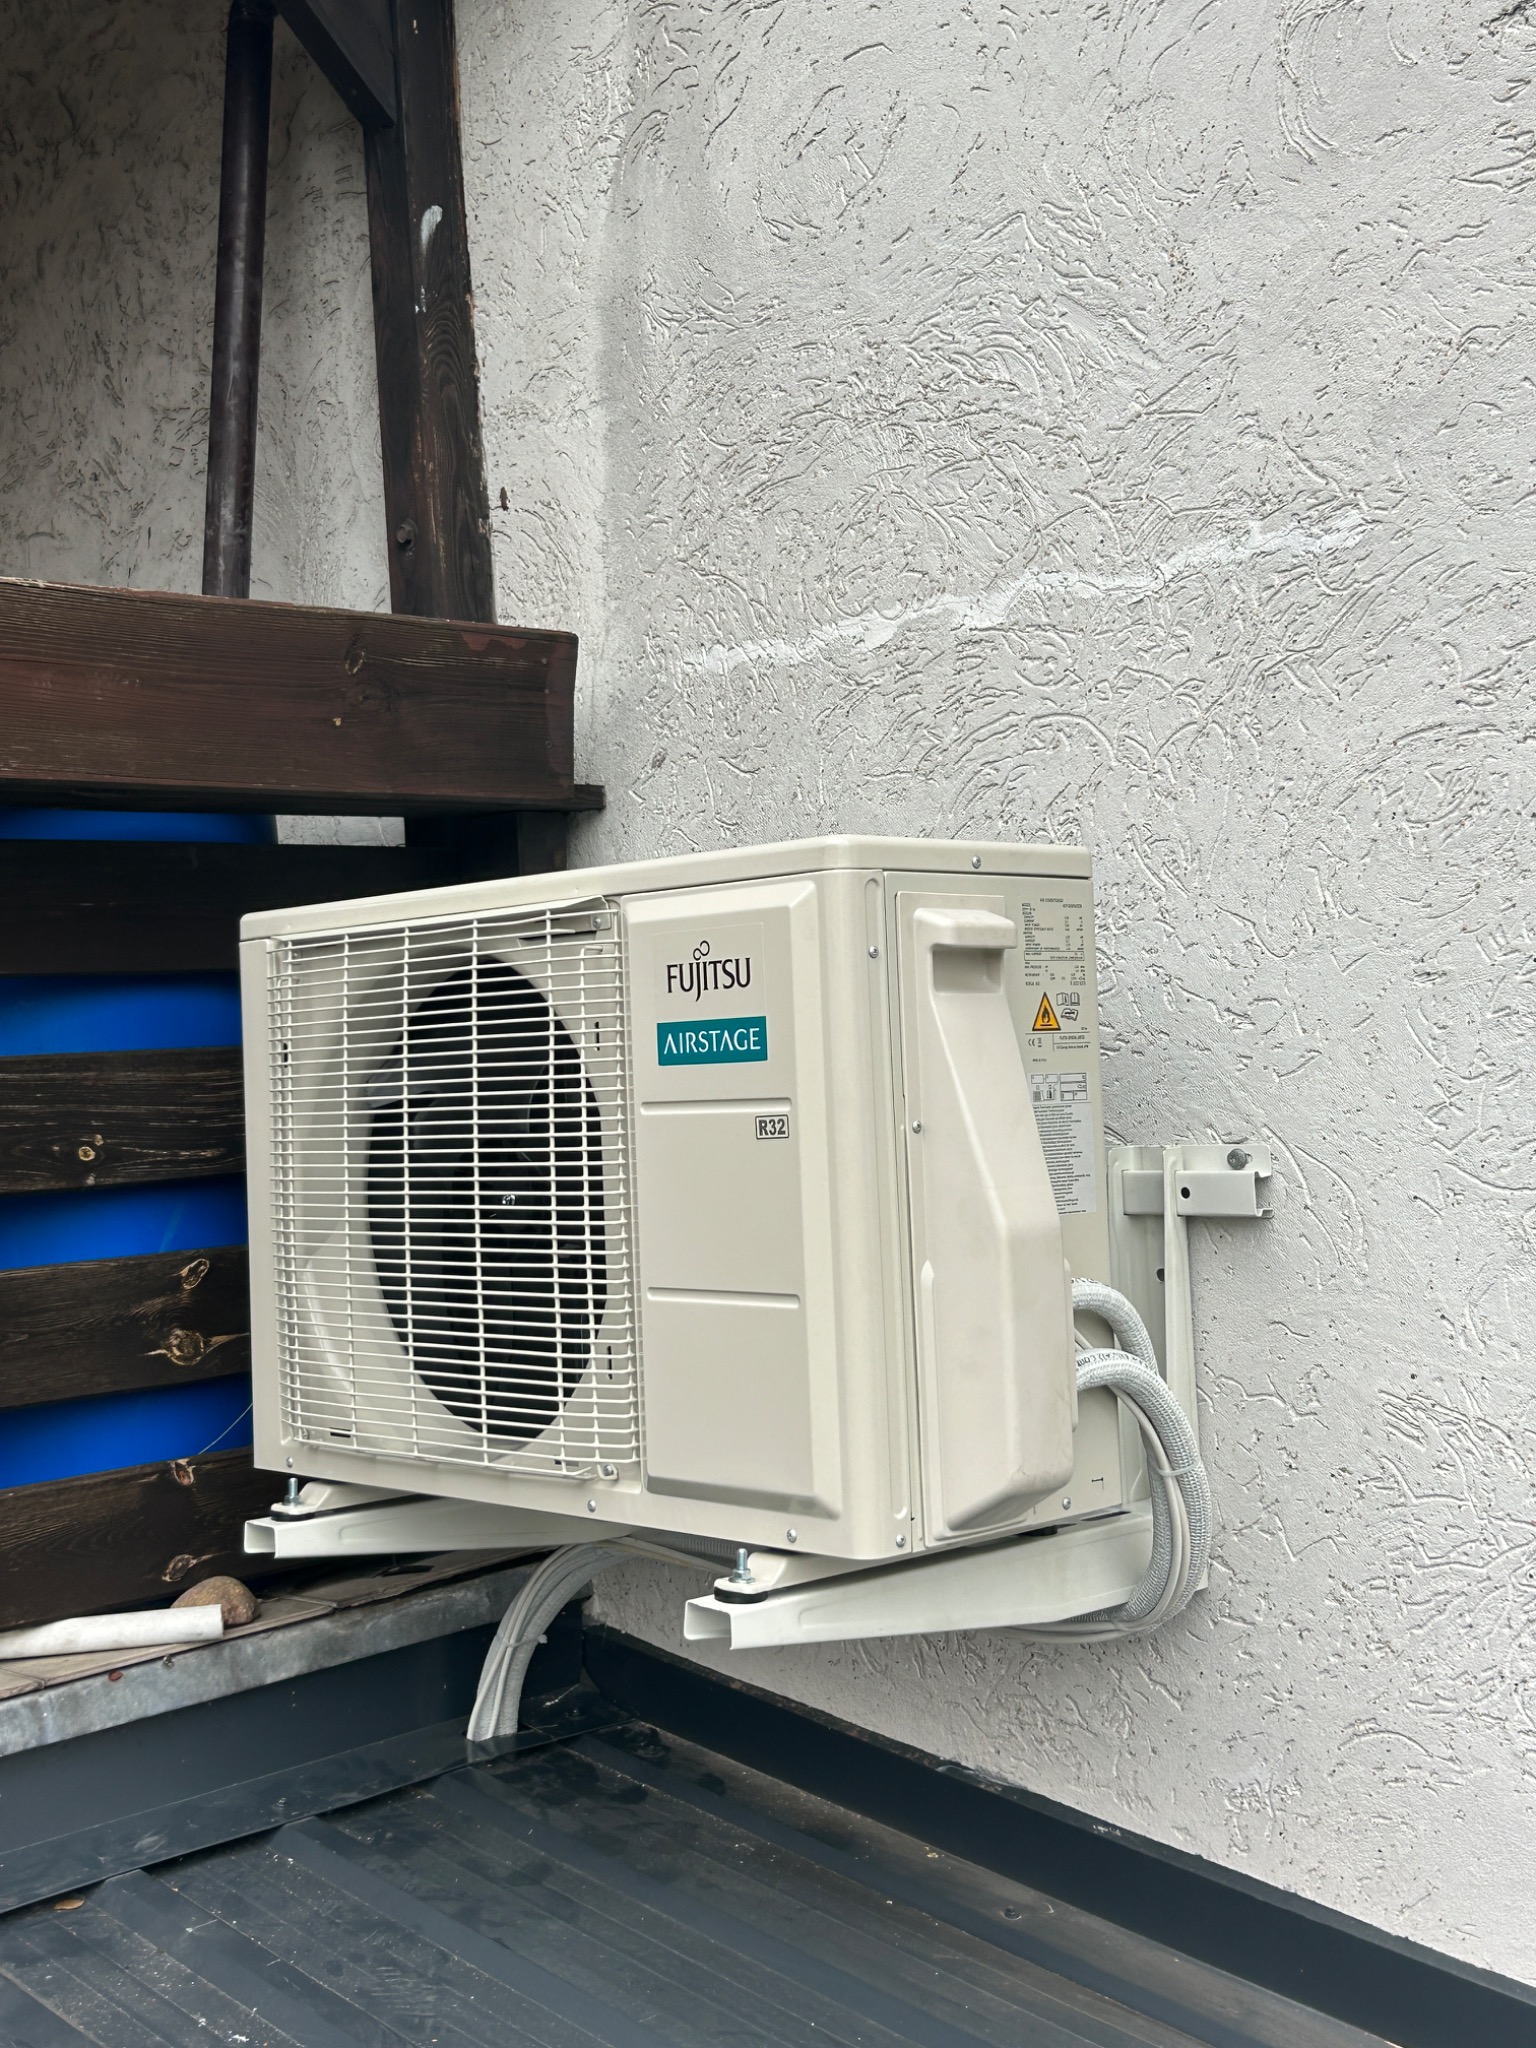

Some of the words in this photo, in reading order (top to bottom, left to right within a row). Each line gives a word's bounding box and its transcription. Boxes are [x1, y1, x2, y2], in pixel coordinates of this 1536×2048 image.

[666, 940, 751, 1002] FUJITSU
[663, 1027, 761, 1055] AIRSTAGE
[758, 1118, 786, 1136] R32
